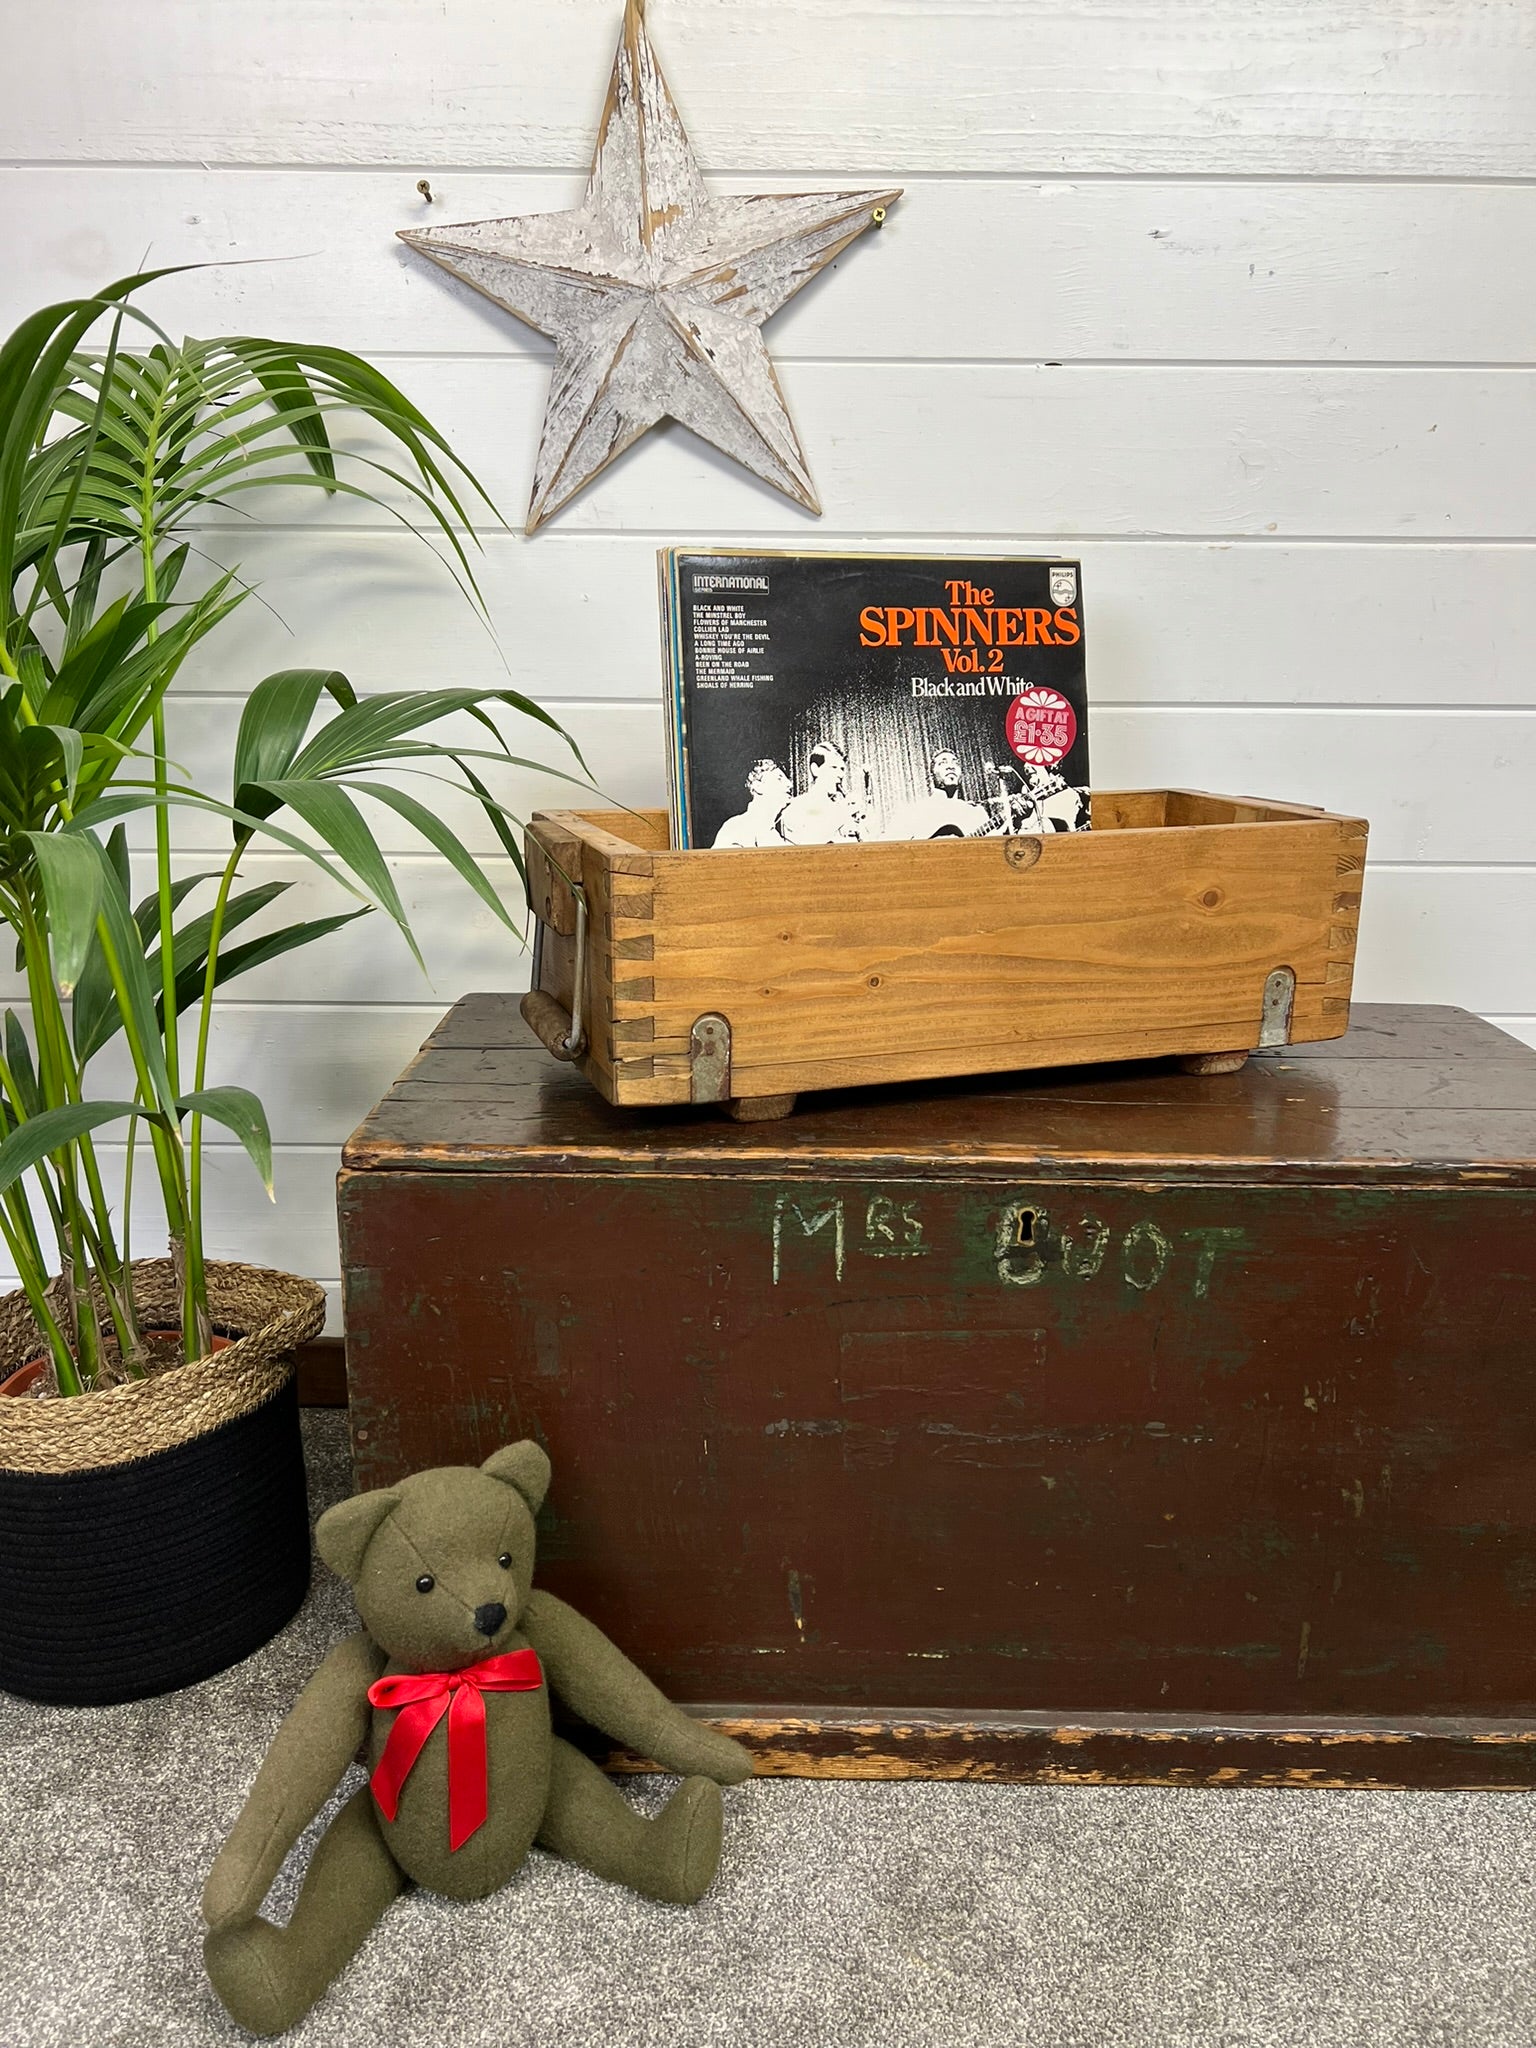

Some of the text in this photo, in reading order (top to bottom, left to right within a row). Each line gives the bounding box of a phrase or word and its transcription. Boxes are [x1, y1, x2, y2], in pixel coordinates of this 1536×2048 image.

[694, 576, 768, 589] INTERNATIONAL
[945, 581, 994, 605] The
[859, 607, 1080, 646] SPINNERS
[941, 649, 1004, 673] Vol. 2
[911, 677, 1035, 697] Black and White
[1015, 707, 1069, 724] A GIFT AT
